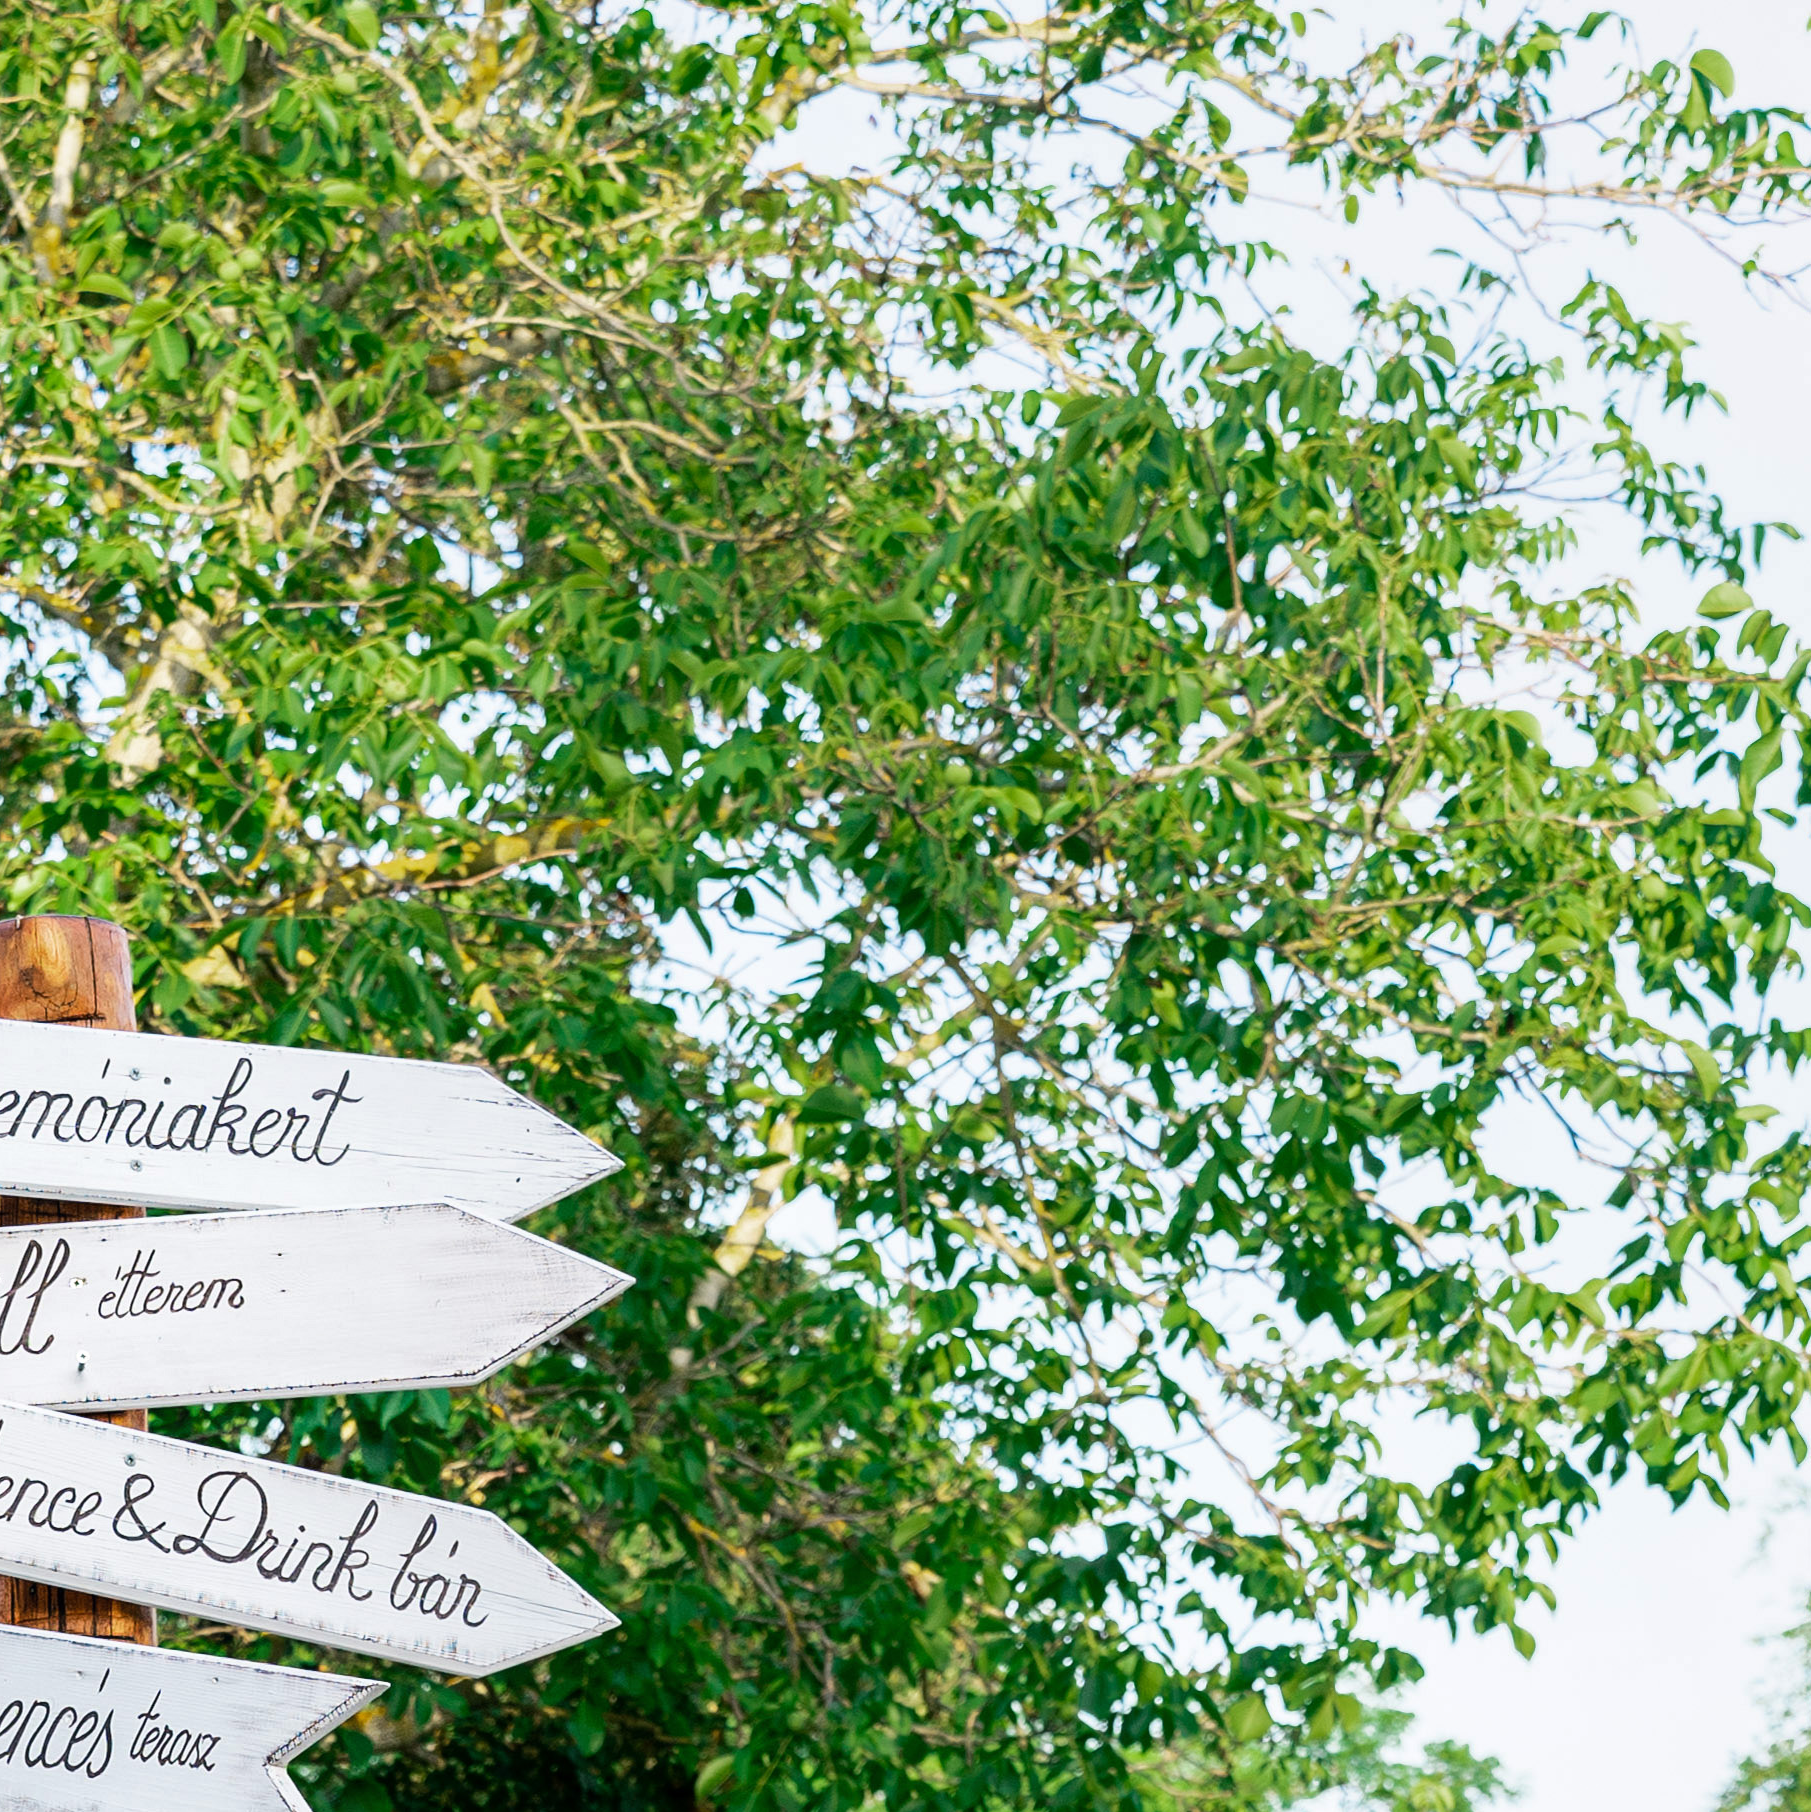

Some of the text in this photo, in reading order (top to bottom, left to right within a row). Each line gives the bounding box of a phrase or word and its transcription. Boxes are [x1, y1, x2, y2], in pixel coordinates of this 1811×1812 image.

[97, 1249, 246, 1322] étterem
[112, 1472, 172, 1555] &
[172, 1469, 379, 1602] Drink
[392, 1512, 491, 1629] bár
[130, 1689, 222, 1772] terasz
